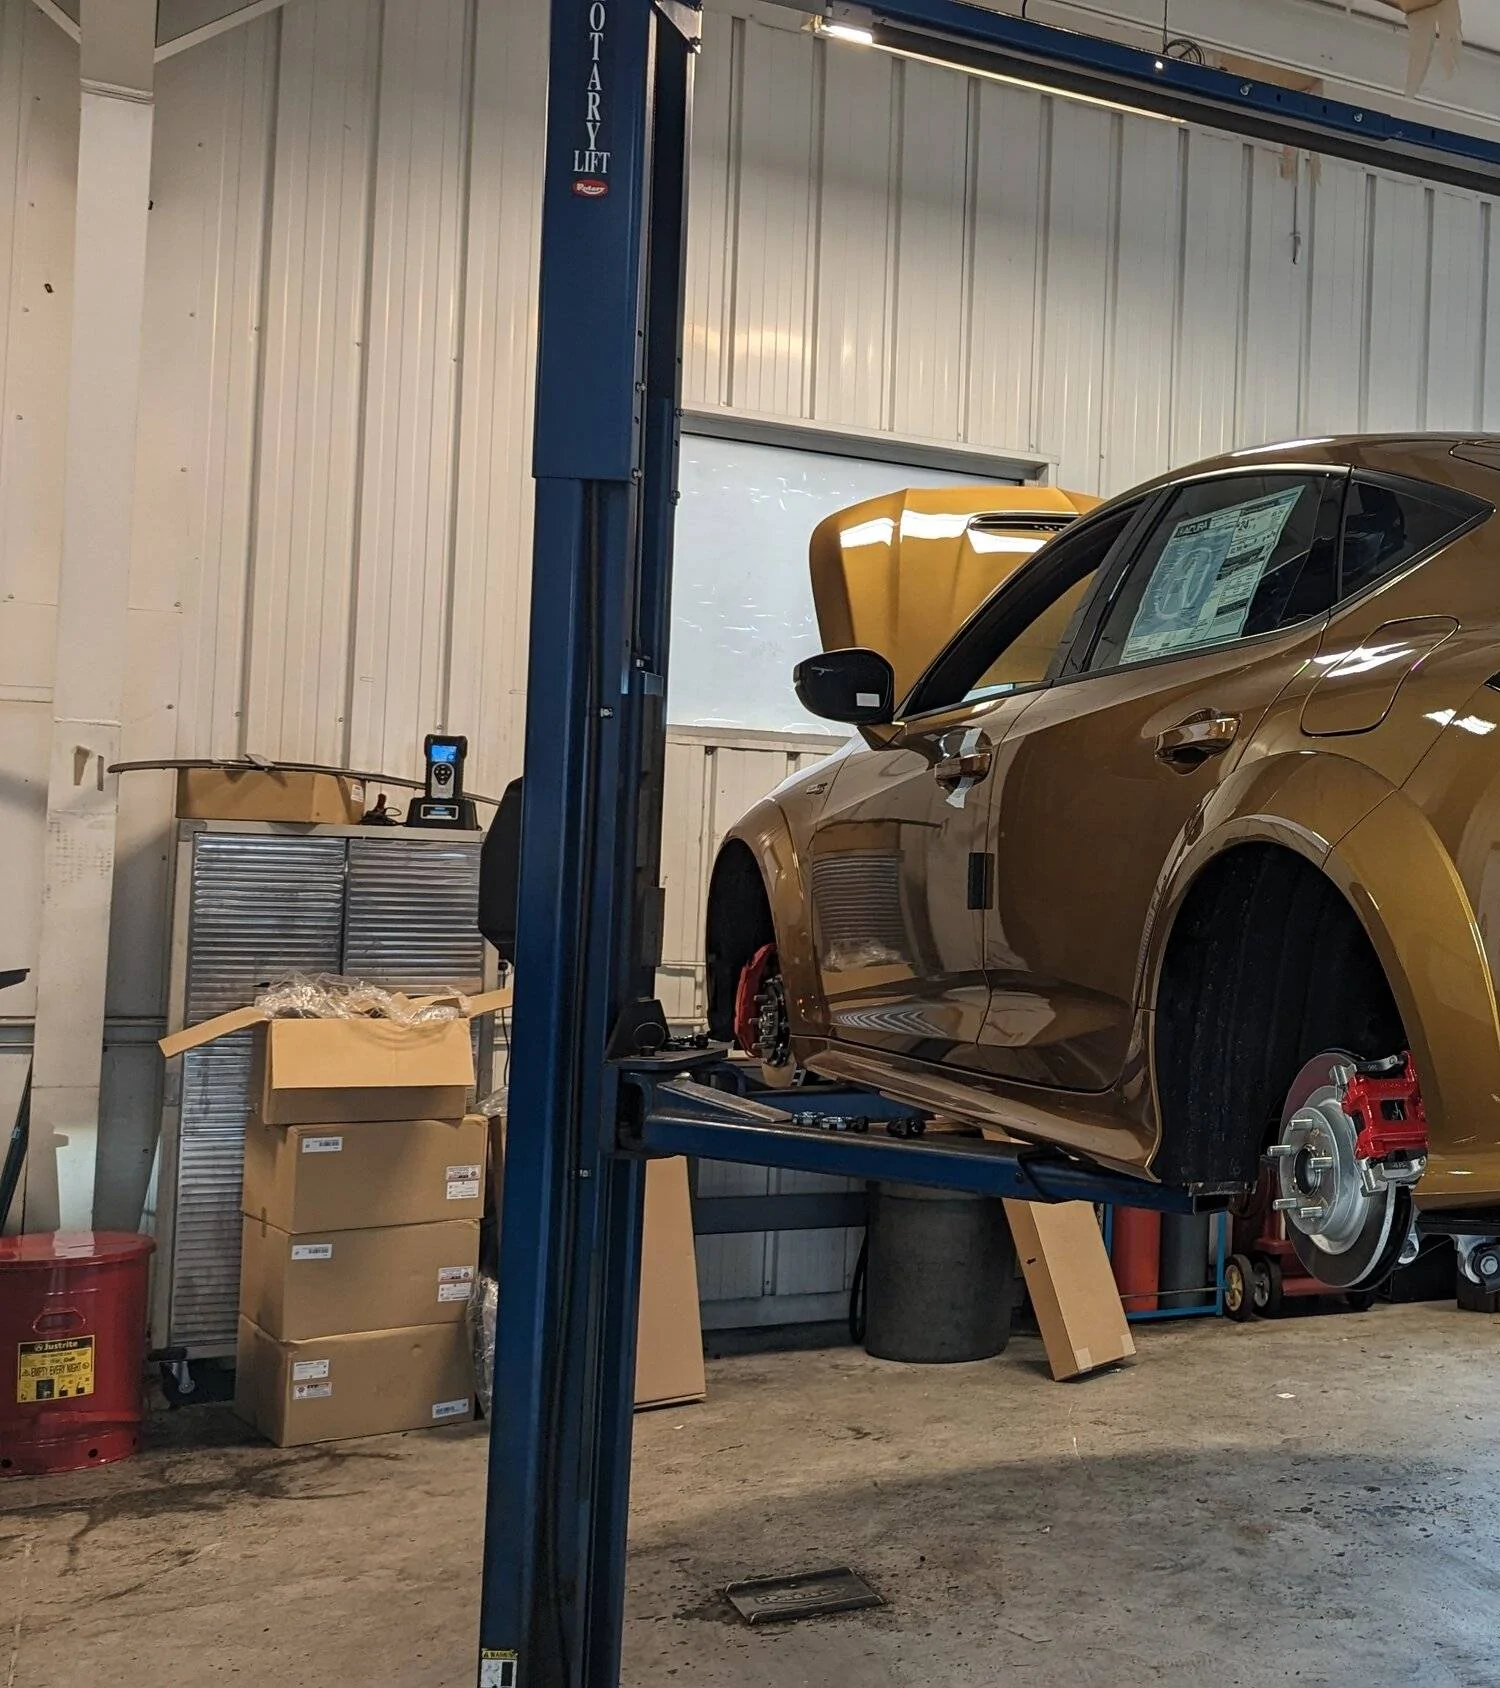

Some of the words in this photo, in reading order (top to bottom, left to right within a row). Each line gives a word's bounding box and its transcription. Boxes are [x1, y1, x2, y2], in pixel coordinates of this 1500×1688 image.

[586, 0, 605, 150] OTARY
[572, 150, 611, 173] LIFT
[44, 1341, 78, 1351] Justrite
[30, 1367, 47, 1377] EMPTY
[49, 1364, 65, 1375] EVERY
